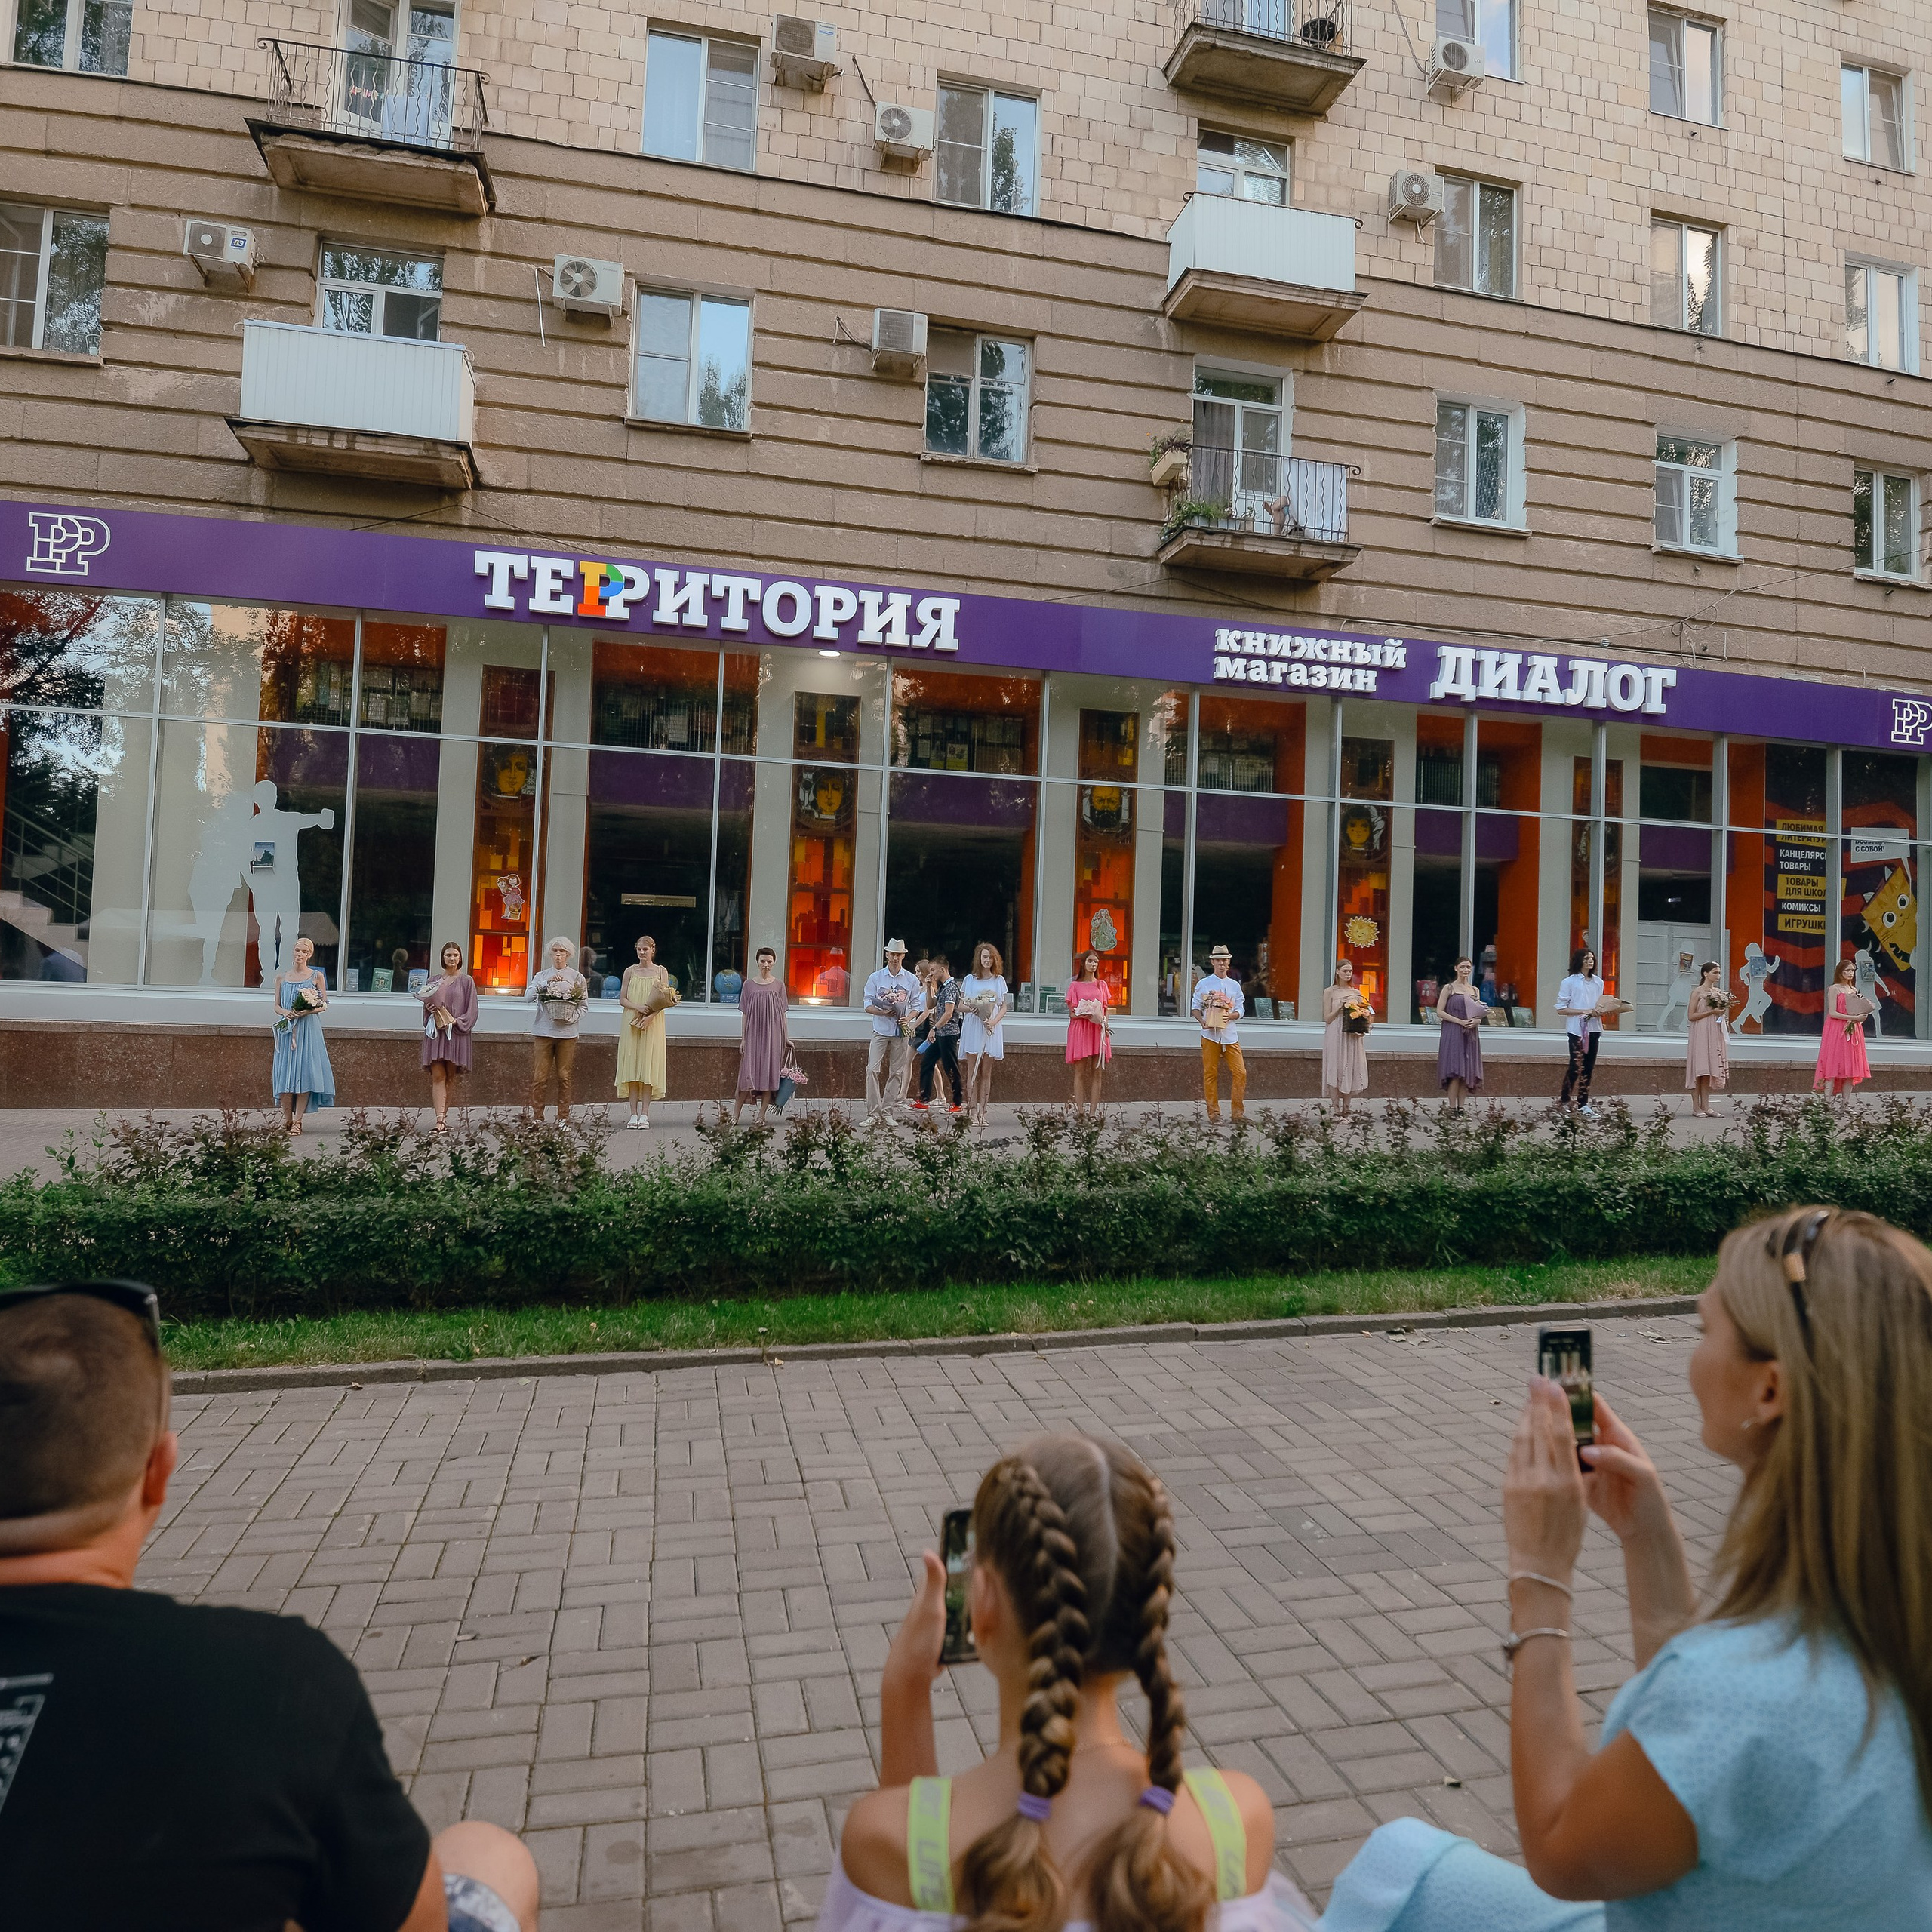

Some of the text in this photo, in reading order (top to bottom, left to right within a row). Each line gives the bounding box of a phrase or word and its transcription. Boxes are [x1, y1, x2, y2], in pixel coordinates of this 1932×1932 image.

[474, 550, 961, 652] ТЕРРИТОРИЯ
[1214, 628, 1407, 669] книжный
[1213, 656, 1377, 692] магазин
[1429, 645, 1677, 714] ДИАЛОГ
[1781, 823, 1824, 833] ЛЮБИМАЯ
[1780, 861, 1811, 871] ТОВАРЫ
[1786, 877, 1819, 888] ТОВАРЫ
[1785, 887, 1802, 897] ДЛЯ
[1781, 902, 1821, 912] КОМИКСЫ
